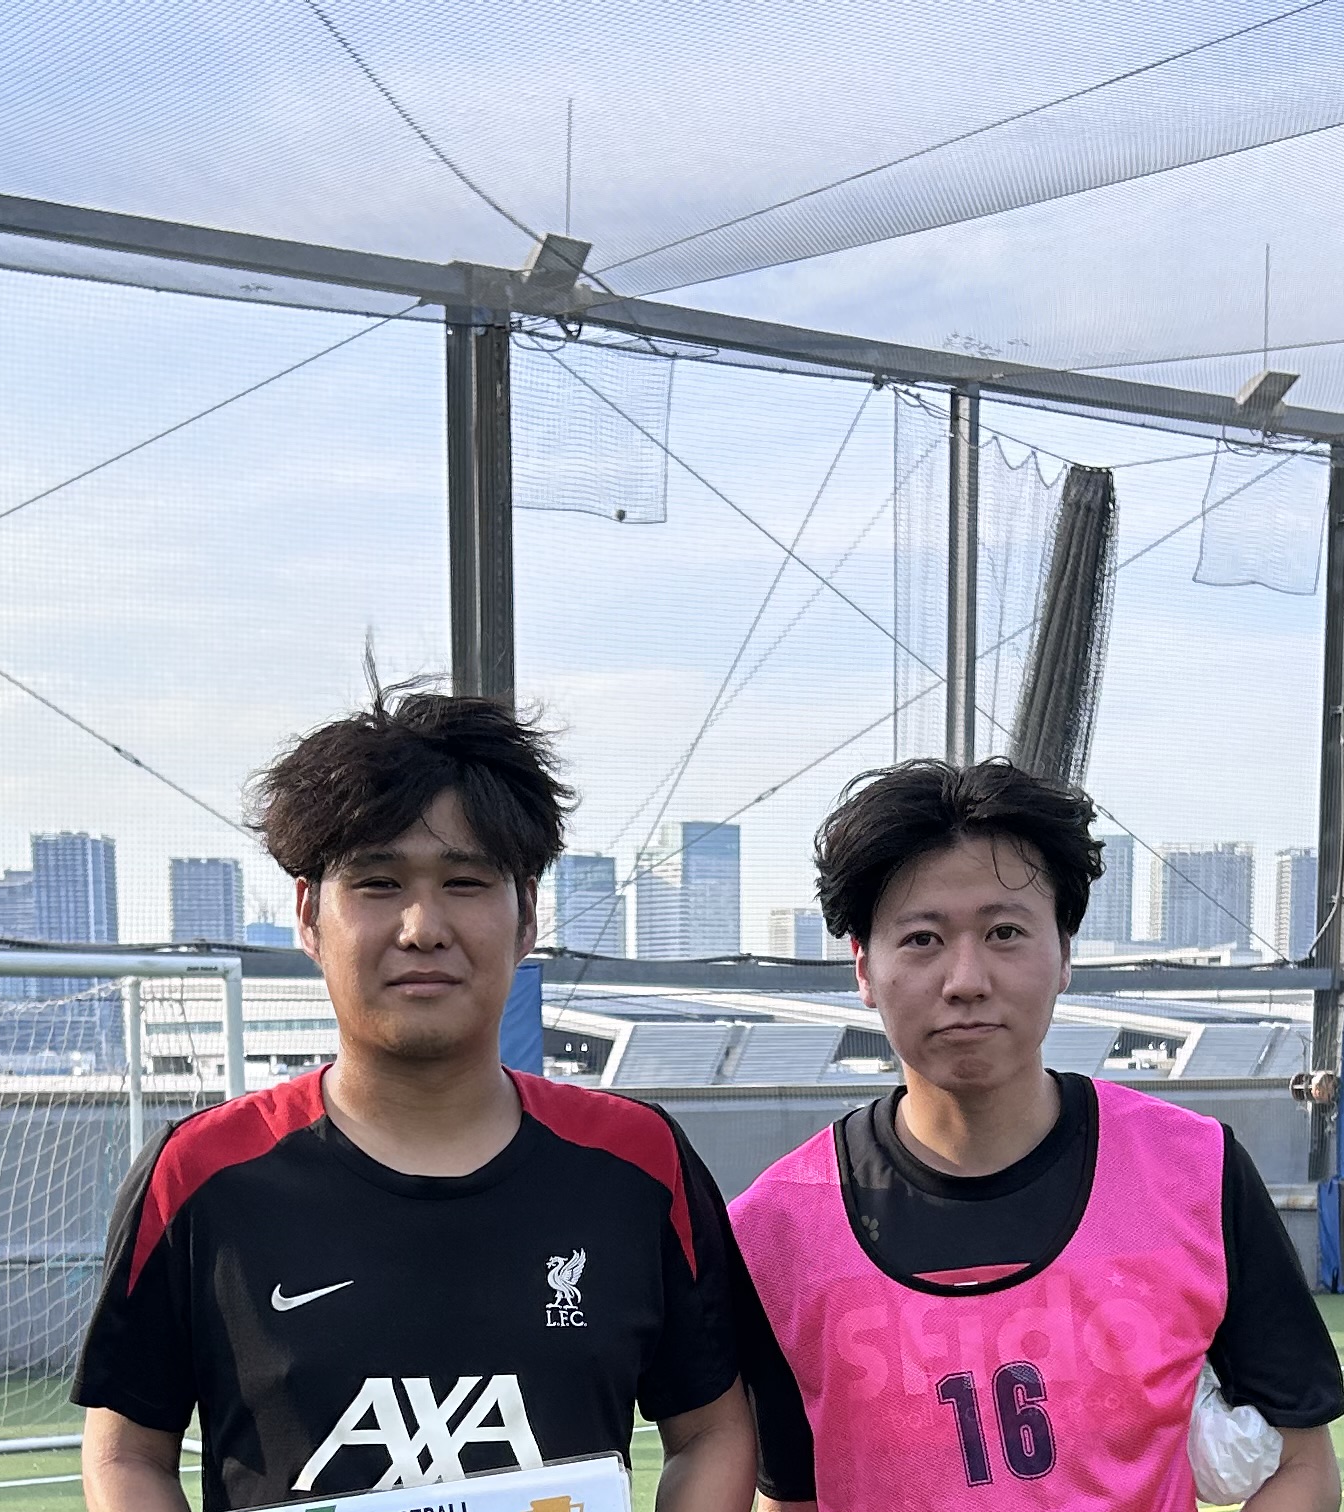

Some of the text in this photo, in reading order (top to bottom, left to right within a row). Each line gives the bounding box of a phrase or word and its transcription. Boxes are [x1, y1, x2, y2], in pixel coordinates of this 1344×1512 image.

[545, 1309, 588, 1327] L.F.C.
[290, 1374, 544, 1492] AXA
[936, 1360, 1058, 1488] 16
